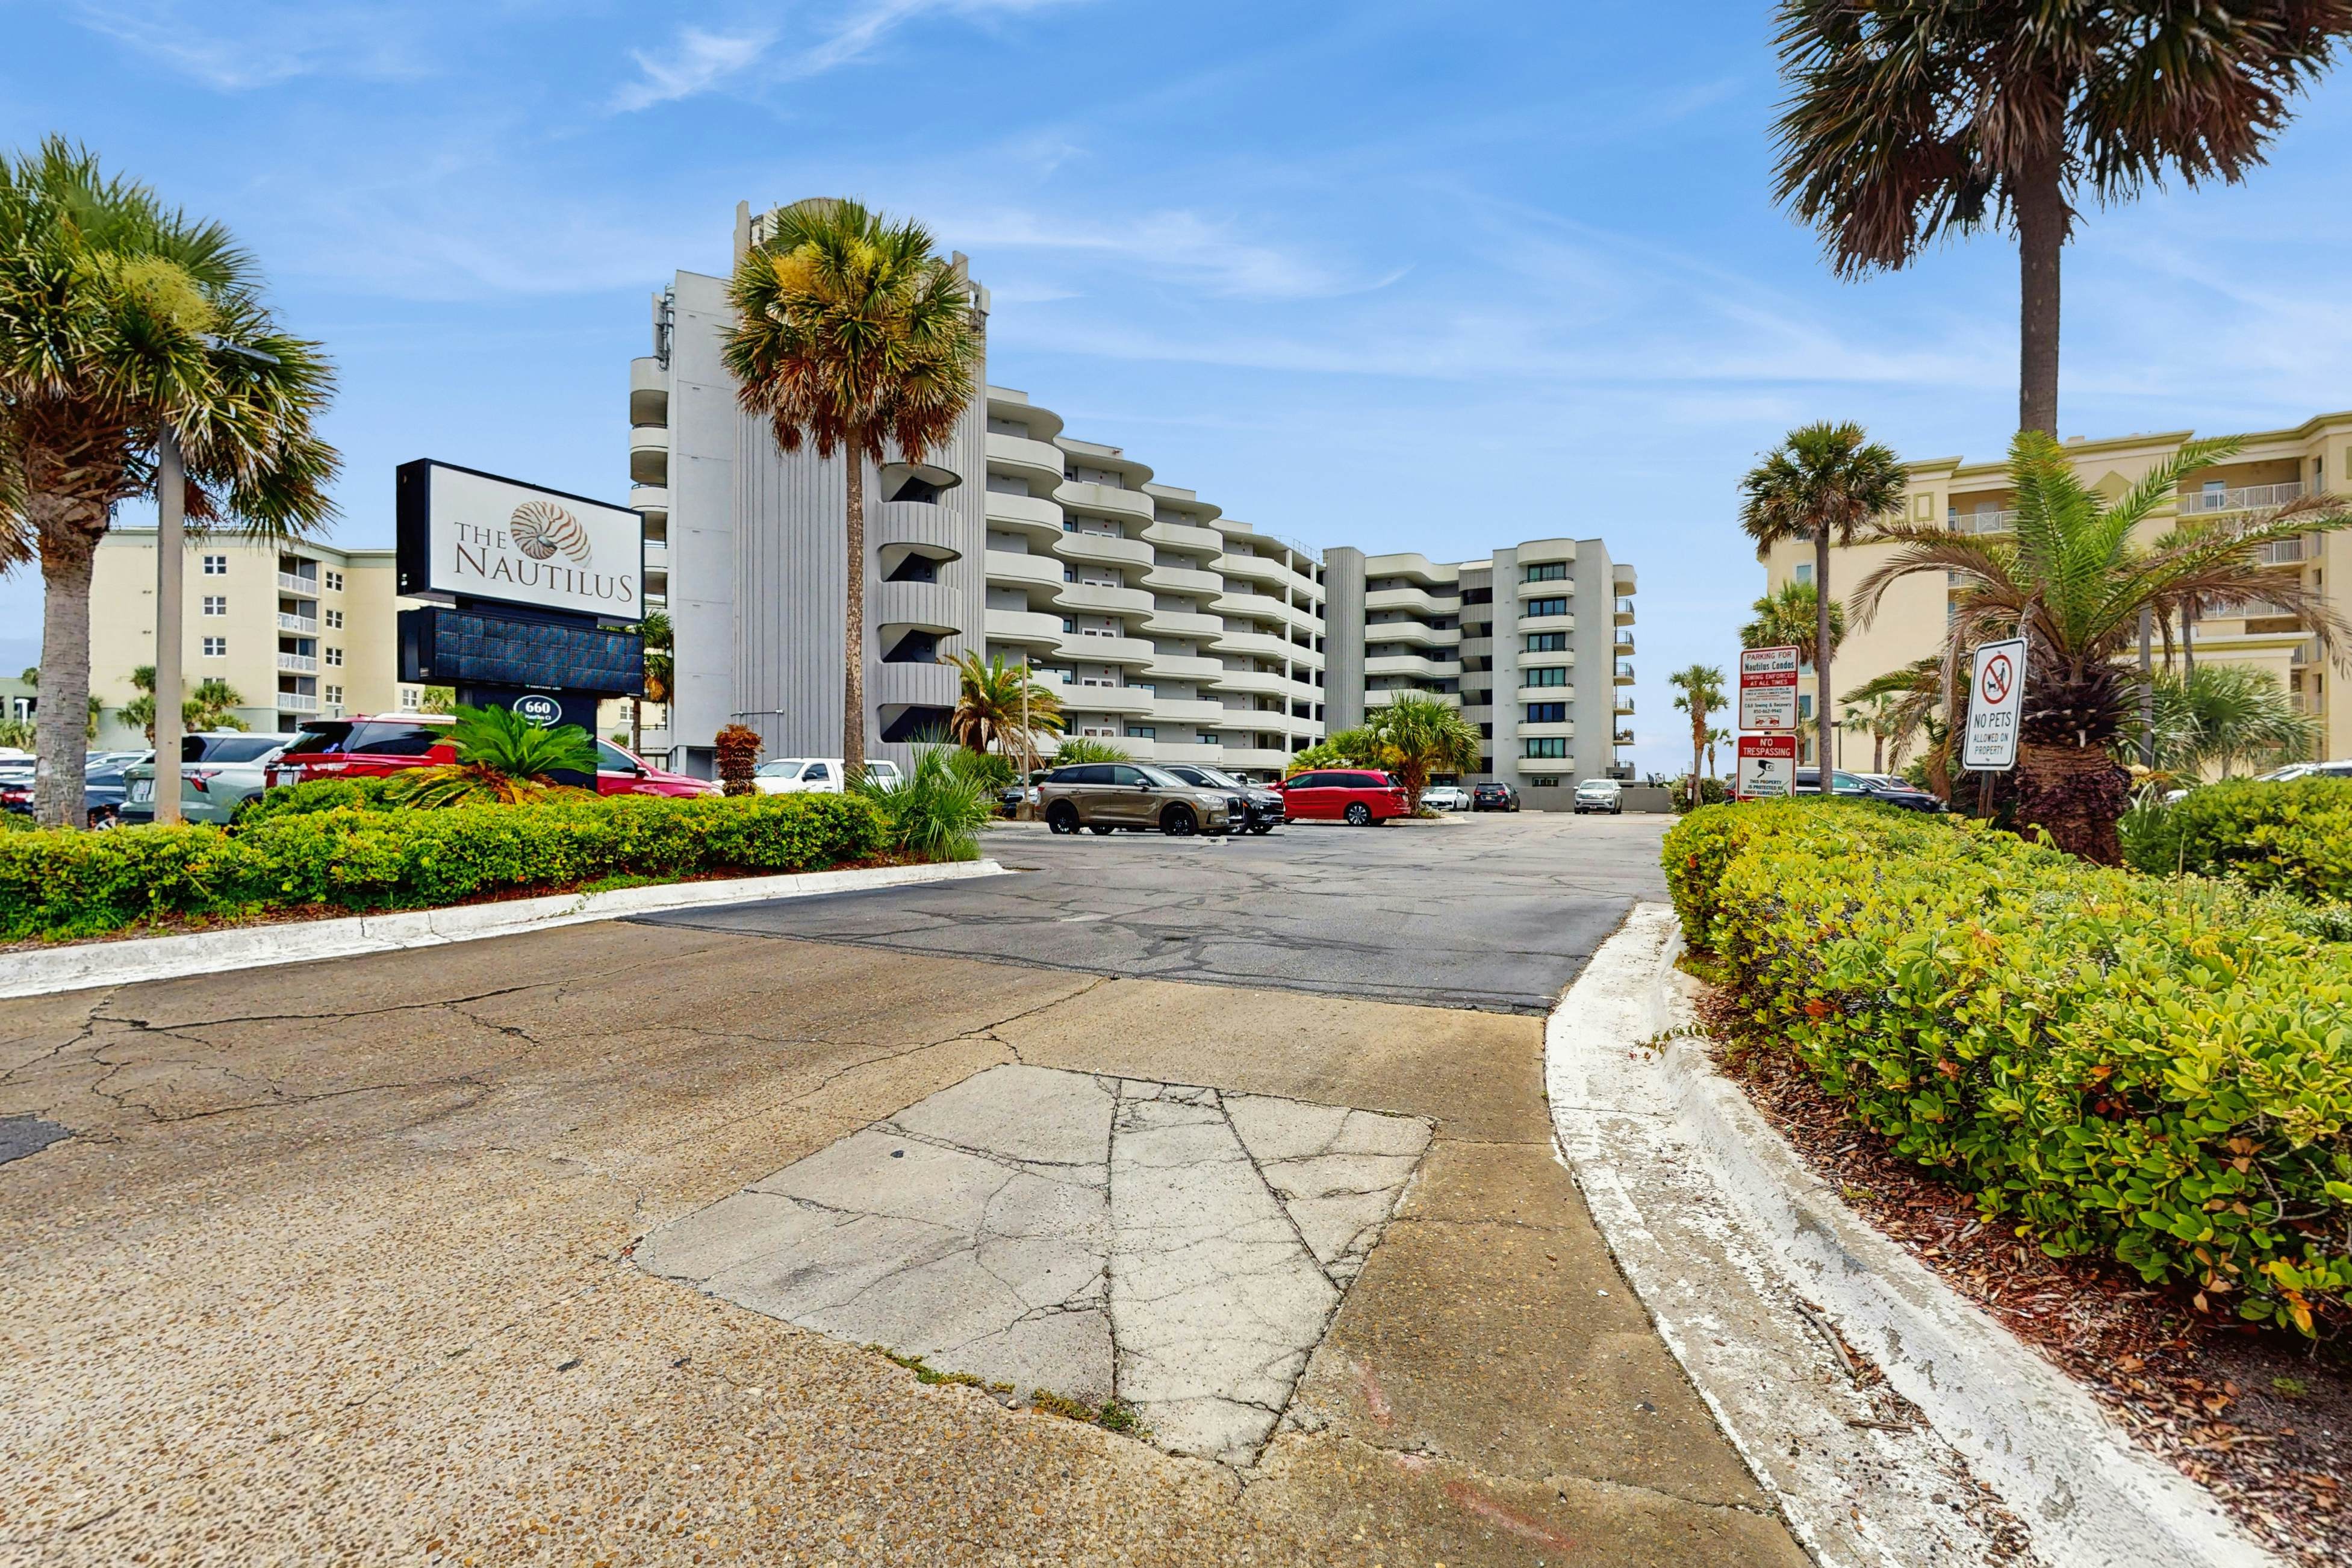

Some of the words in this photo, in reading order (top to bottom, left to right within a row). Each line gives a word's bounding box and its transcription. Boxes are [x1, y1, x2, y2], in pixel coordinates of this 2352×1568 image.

[454, 521, 506, 549] THE
[453, 541, 632, 602] NAUTILUS
[1747, 652, 1775, 661] PARKING
[1744, 662, 1770, 671] Nautilus
[1772, 661, 1794, 670] Condos
[525, 701, 551, 714] 660
[1974, 713, 1986, 728] NO
[1989, 711, 2011, 727] PETS
[1973, 733, 1999, 742] ALLOWED
[2000, 733, 2009, 742] ON
[1760, 738, 1773, 747] NO
[1743, 747, 1791, 756] TRESPASSING
[1974, 745, 2003, 754] PROPERTY
